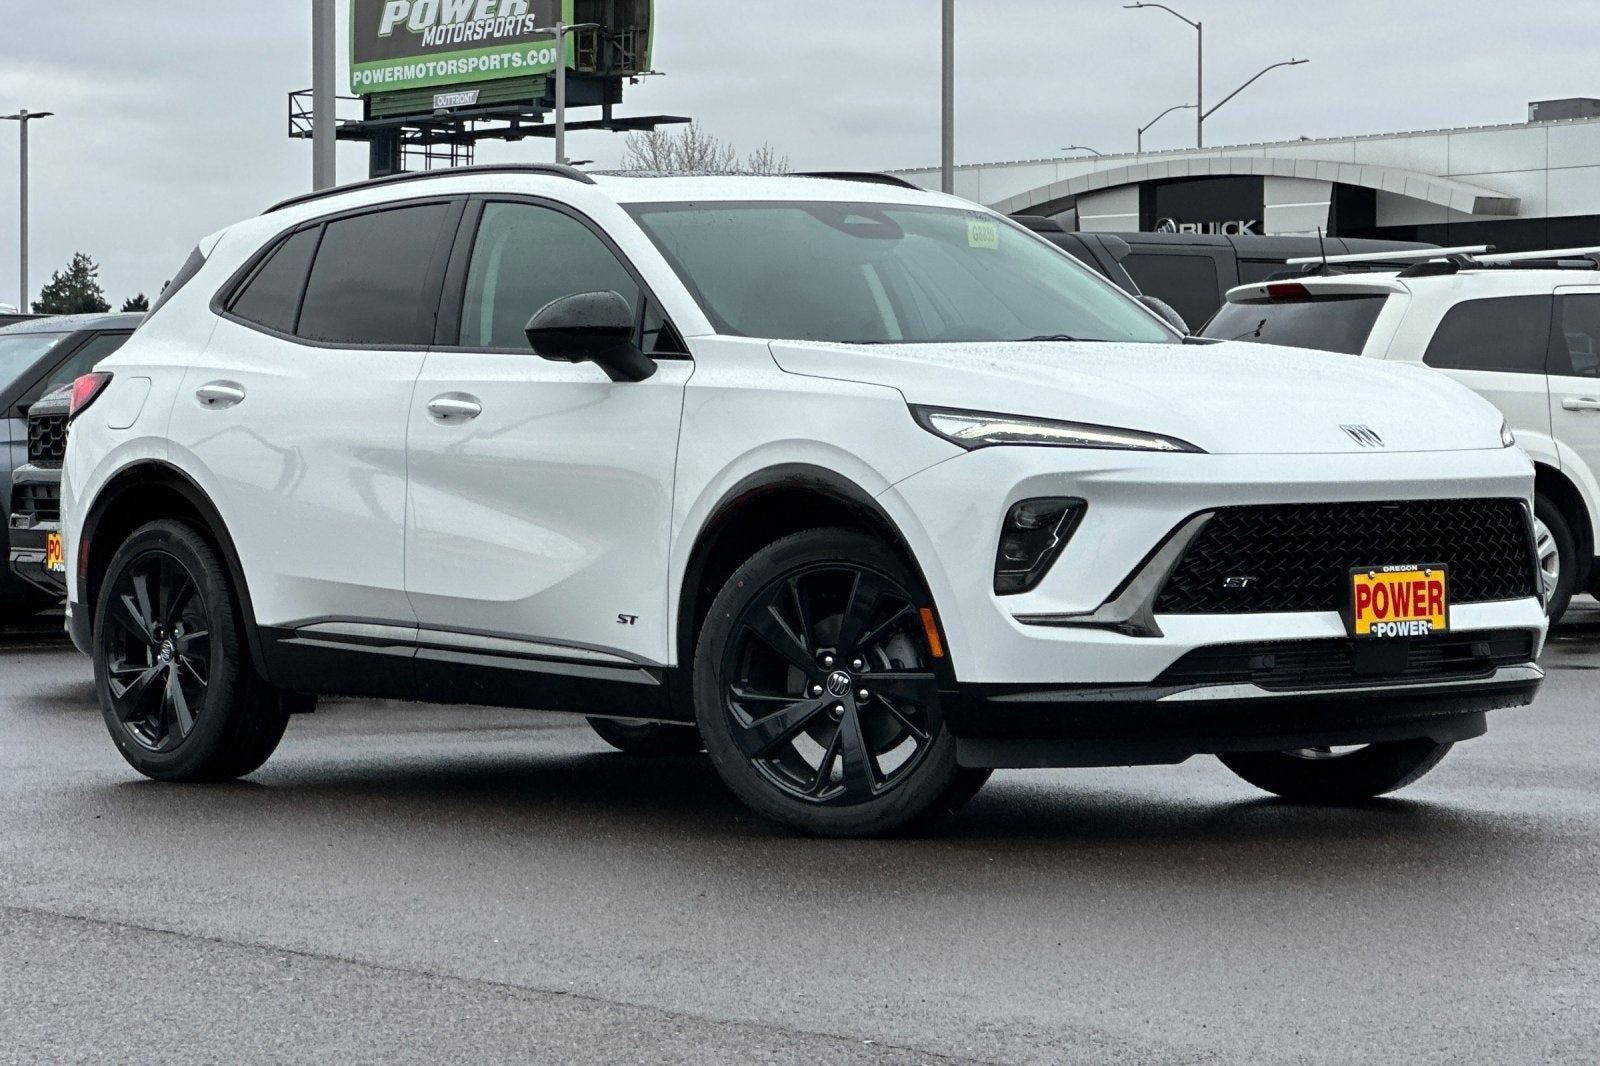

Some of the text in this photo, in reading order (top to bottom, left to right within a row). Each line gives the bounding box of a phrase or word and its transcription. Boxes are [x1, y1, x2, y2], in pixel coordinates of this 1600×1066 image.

[421, 13, 536, 47] MOTORSPORTS
[437, 92, 475, 106] OUTFRONT
[1382, 565, 1418, 573] OREGON
[1356, 580, 1443, 620] POWER
[616, 613, 639, 625] ST
[1377, 620, 1429, 638] POWER
